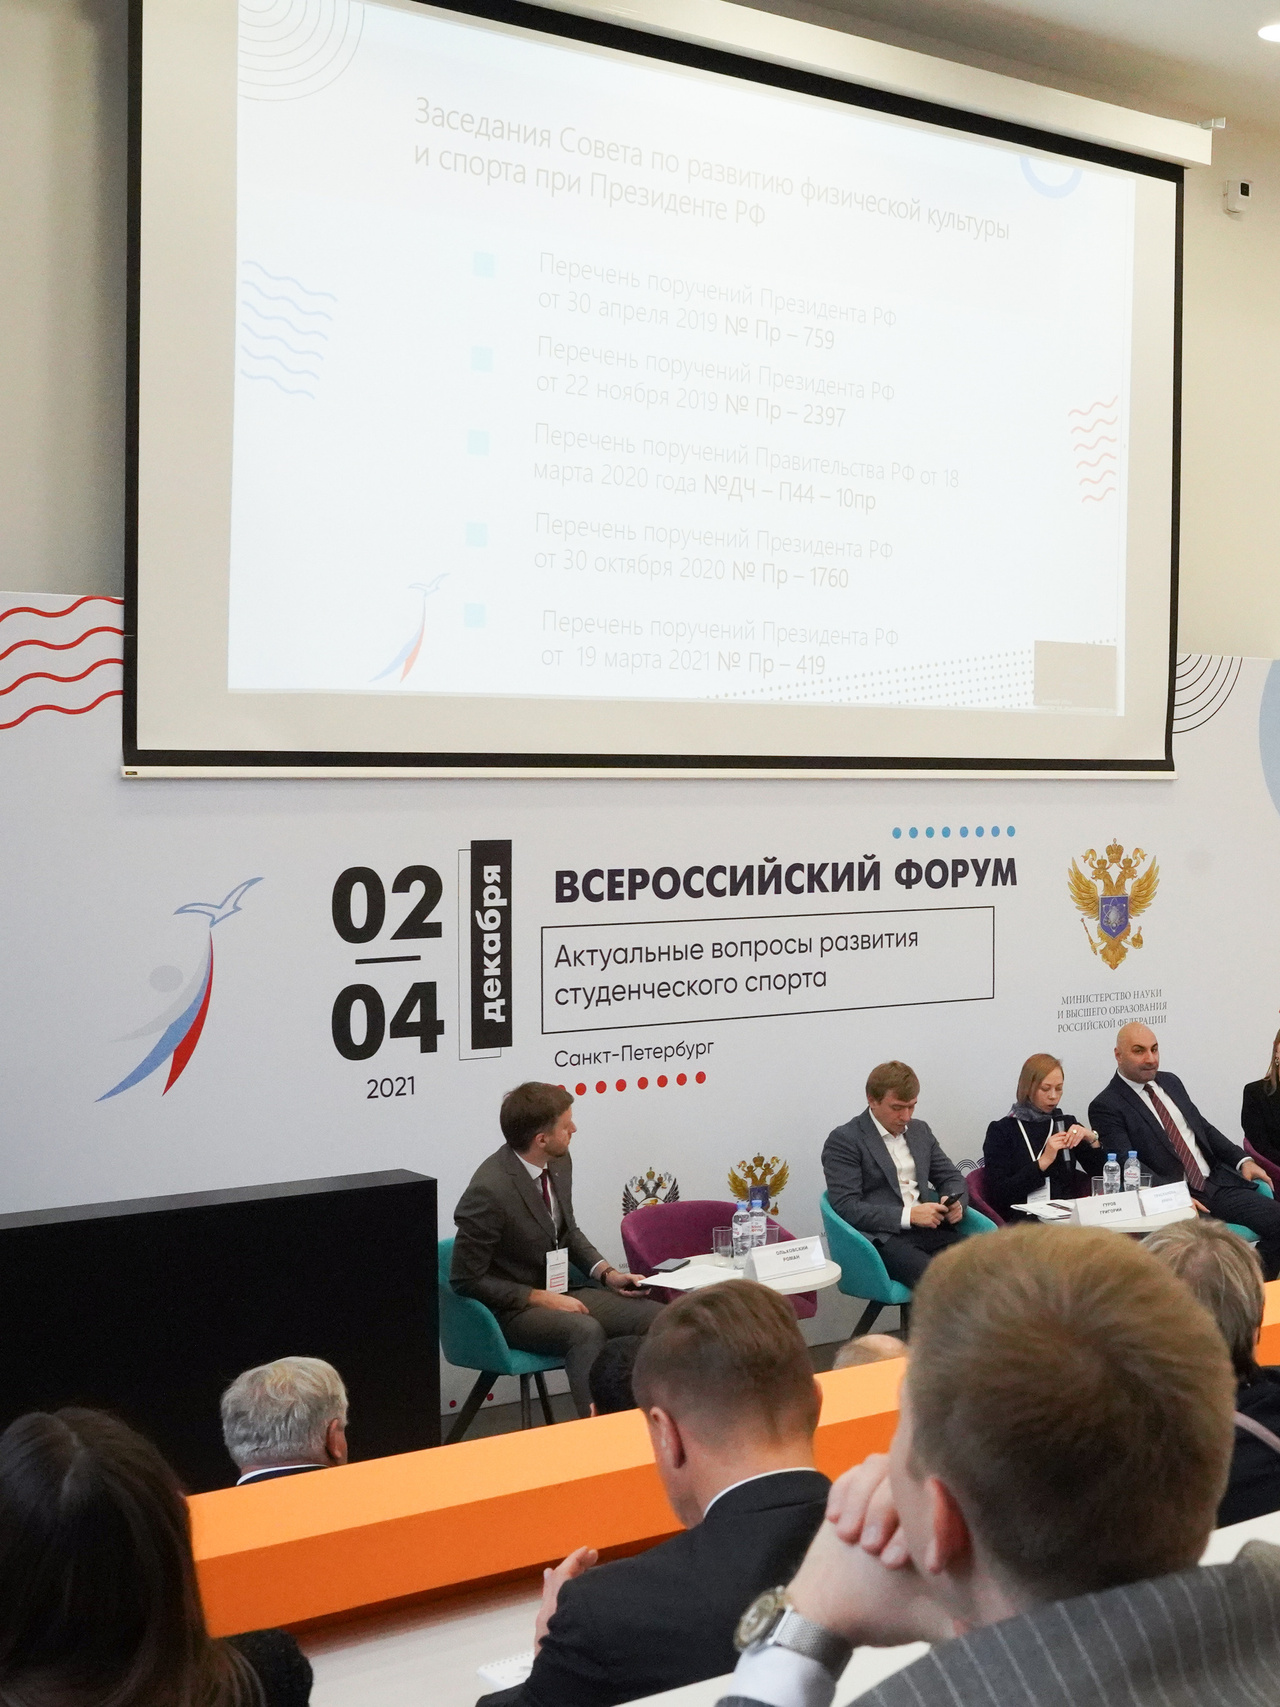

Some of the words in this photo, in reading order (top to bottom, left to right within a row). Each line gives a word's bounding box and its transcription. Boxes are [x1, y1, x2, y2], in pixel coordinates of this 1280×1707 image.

[415, 97, 551, 148] Заседания
[560, 127, 642, 167] Совета
[651, 151, 679, 173] по
[688, 158, 793, 196] развитию
[801, 176, 920, 222] физической
[927, 207, 1010, 242] культуры
[415, 144, 429, 167] и
[439, 150, 526, 186] спорта
[536, 168, 581, 198] при
[591, 172, 727, 220] Президенте
[735, 199, 766, 227] РФ
[540, 252, 640, 288] Перечень
[648, 274, 753, 305] поручений
[761, 288, 867, 324] Президента
[873, 306, 897, 329] РФ
[539, 292, 560, 309] от
[568, 291, 591, 313] 30
[599, 301, 668, 326] апреля
[676, 308, 718, 332] 2019
[725, 315, 748, 336] №
[756, 319, 781, 347] Пр
[803, 326, 835, 350] 759
[538, 335, 638, 369] Перечень
[646, 355, 751, 384] поручений
[759, 366, 865, 399] Президента
[871, 381, 895, 403] РФ
[537, 376, 558, 392] от
[565, 374, 589, 396] 22
[597, 382, 669, 410] ноября
[676, 388, 718, 411] 2019
[726, 394, 748, 415] №
[756, 398, 781, 424] Пр
[803, 404, 846, 427] 2397
[535, 422, 636, 453] Перечень
[643, 439, 748, 466] поручений
[756, 446, 885, 480] Правительства
[891, 462, 914, 482] РФ
[920, 470, 937, 486] от
[943, 469, 959, 488] 18
[534, 462, 593, 487] марта
[601, 463, 648, 488] 2020
[656, 473, 696, 494] года
[779, 481, 815, 504] П44
[836, 488, 876, 515] 10пр
[536, 512, 637, 541] Перечень
[644, 525, 749, 550] поручений
[757, 530, 863, 558] Президента
[870, 540, 893, 559] РФ
[534, 552, 556, 568] от
[563, 549, 587, 570] 30
[594, 554, 672, 581] октября
[680, 557, 725, 580] 2020
[732, 560, 755, 581] №
[763, 563, 788, 589] Пр
[810, 567, 849, 588] 1760
[543, 610, 643, 639] Перечень
[651, 619, 755, 643] поручений
[763, 621, 868, 647] Президента
[875, 628, 898, 647] РФ
[541, 650, 563, 665] от
[577, 646, 596, 667] 19
[604, 651, 662, 674] марта
[669, 649, 710, 670] 2021
[718, 650, 740, 671] №
[748, 652, 774, 679] Пр
[796, 654, 826, 675] 419
[554, 854, 882, 904] ВСЕРОССИЙСКИЙ
[894, 856, 1018, 890] ФОРУМ
[331, 864, 444, 945] 02
[477, 864, 505, 1024] декабря
[554, 939, 705, 969] Актуальные
[711, 935, 814, 964] вопросы
[819, 930, 919, 958] развития
[554, 974, 739, 1010] студенческого
[745, 967, 828, 998] спорта
[1057, 1010, 1064, 1019] И
[1066, 1006, 1107, 1019] ВЫСШЕГО
[1109, 1002, 1167, 1015] ОБРАЗОВАНИЯ
[1061, 990, 1131, 1005] МИНИСТЕРСТВО
[1133, 989, 1162, 999] НАУКИ
[331, 981, 445, 1062] 04
[1057, 1018, 1116, 1033] РОССИЙСКОЙ
[554, 1037, 715, 1069] Санкт-Петербург
[366, 1075, 416, 1100] 2021
